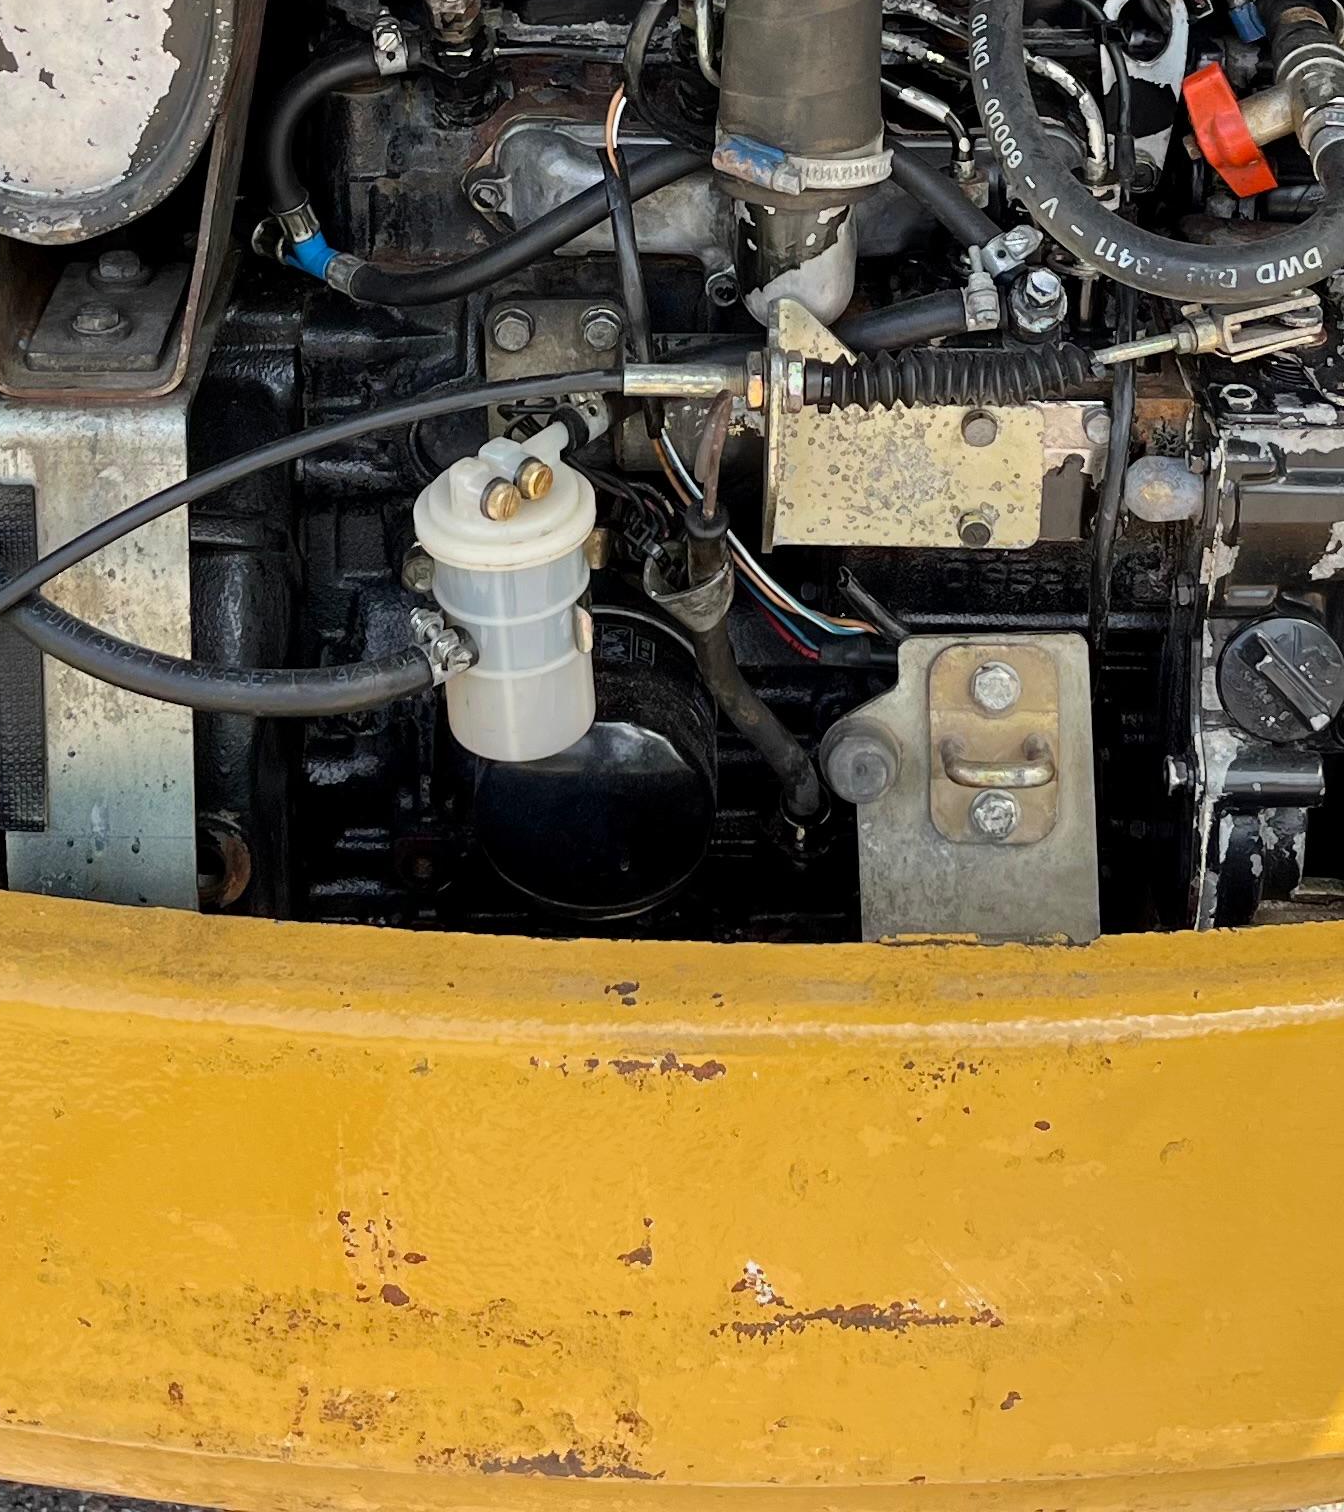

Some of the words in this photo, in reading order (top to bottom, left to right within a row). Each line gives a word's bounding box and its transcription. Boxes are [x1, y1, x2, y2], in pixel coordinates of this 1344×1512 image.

[971, 13, 989, 35] 10
[972, 36, 991, 71] DN
[983, 98, 1024, 170] 60000
[1039, 196, 1061, 220] V
[1255, 245, 1324, 285] DWD
